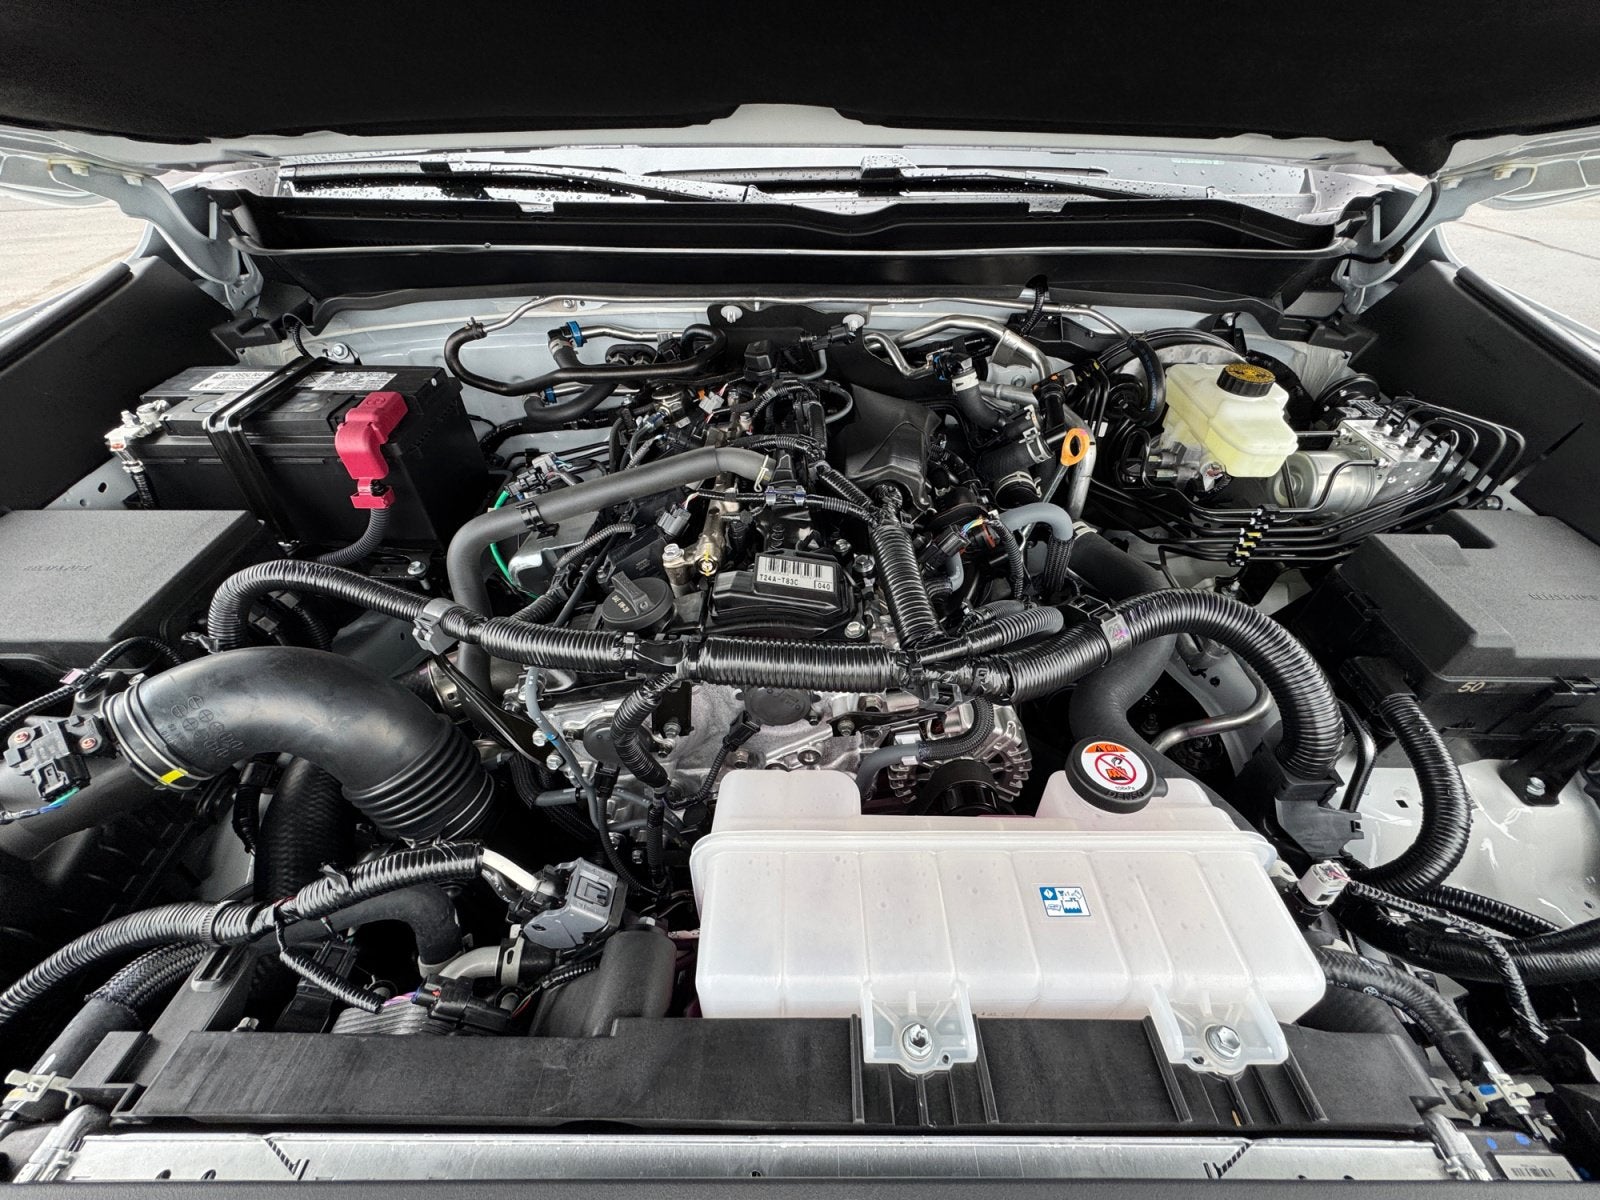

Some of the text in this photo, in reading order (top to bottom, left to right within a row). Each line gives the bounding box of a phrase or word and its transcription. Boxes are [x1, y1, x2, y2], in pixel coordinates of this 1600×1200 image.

[760, 574, 831, 590] T24A-T83C 040
[1457, 680, 1486, 693] 50
